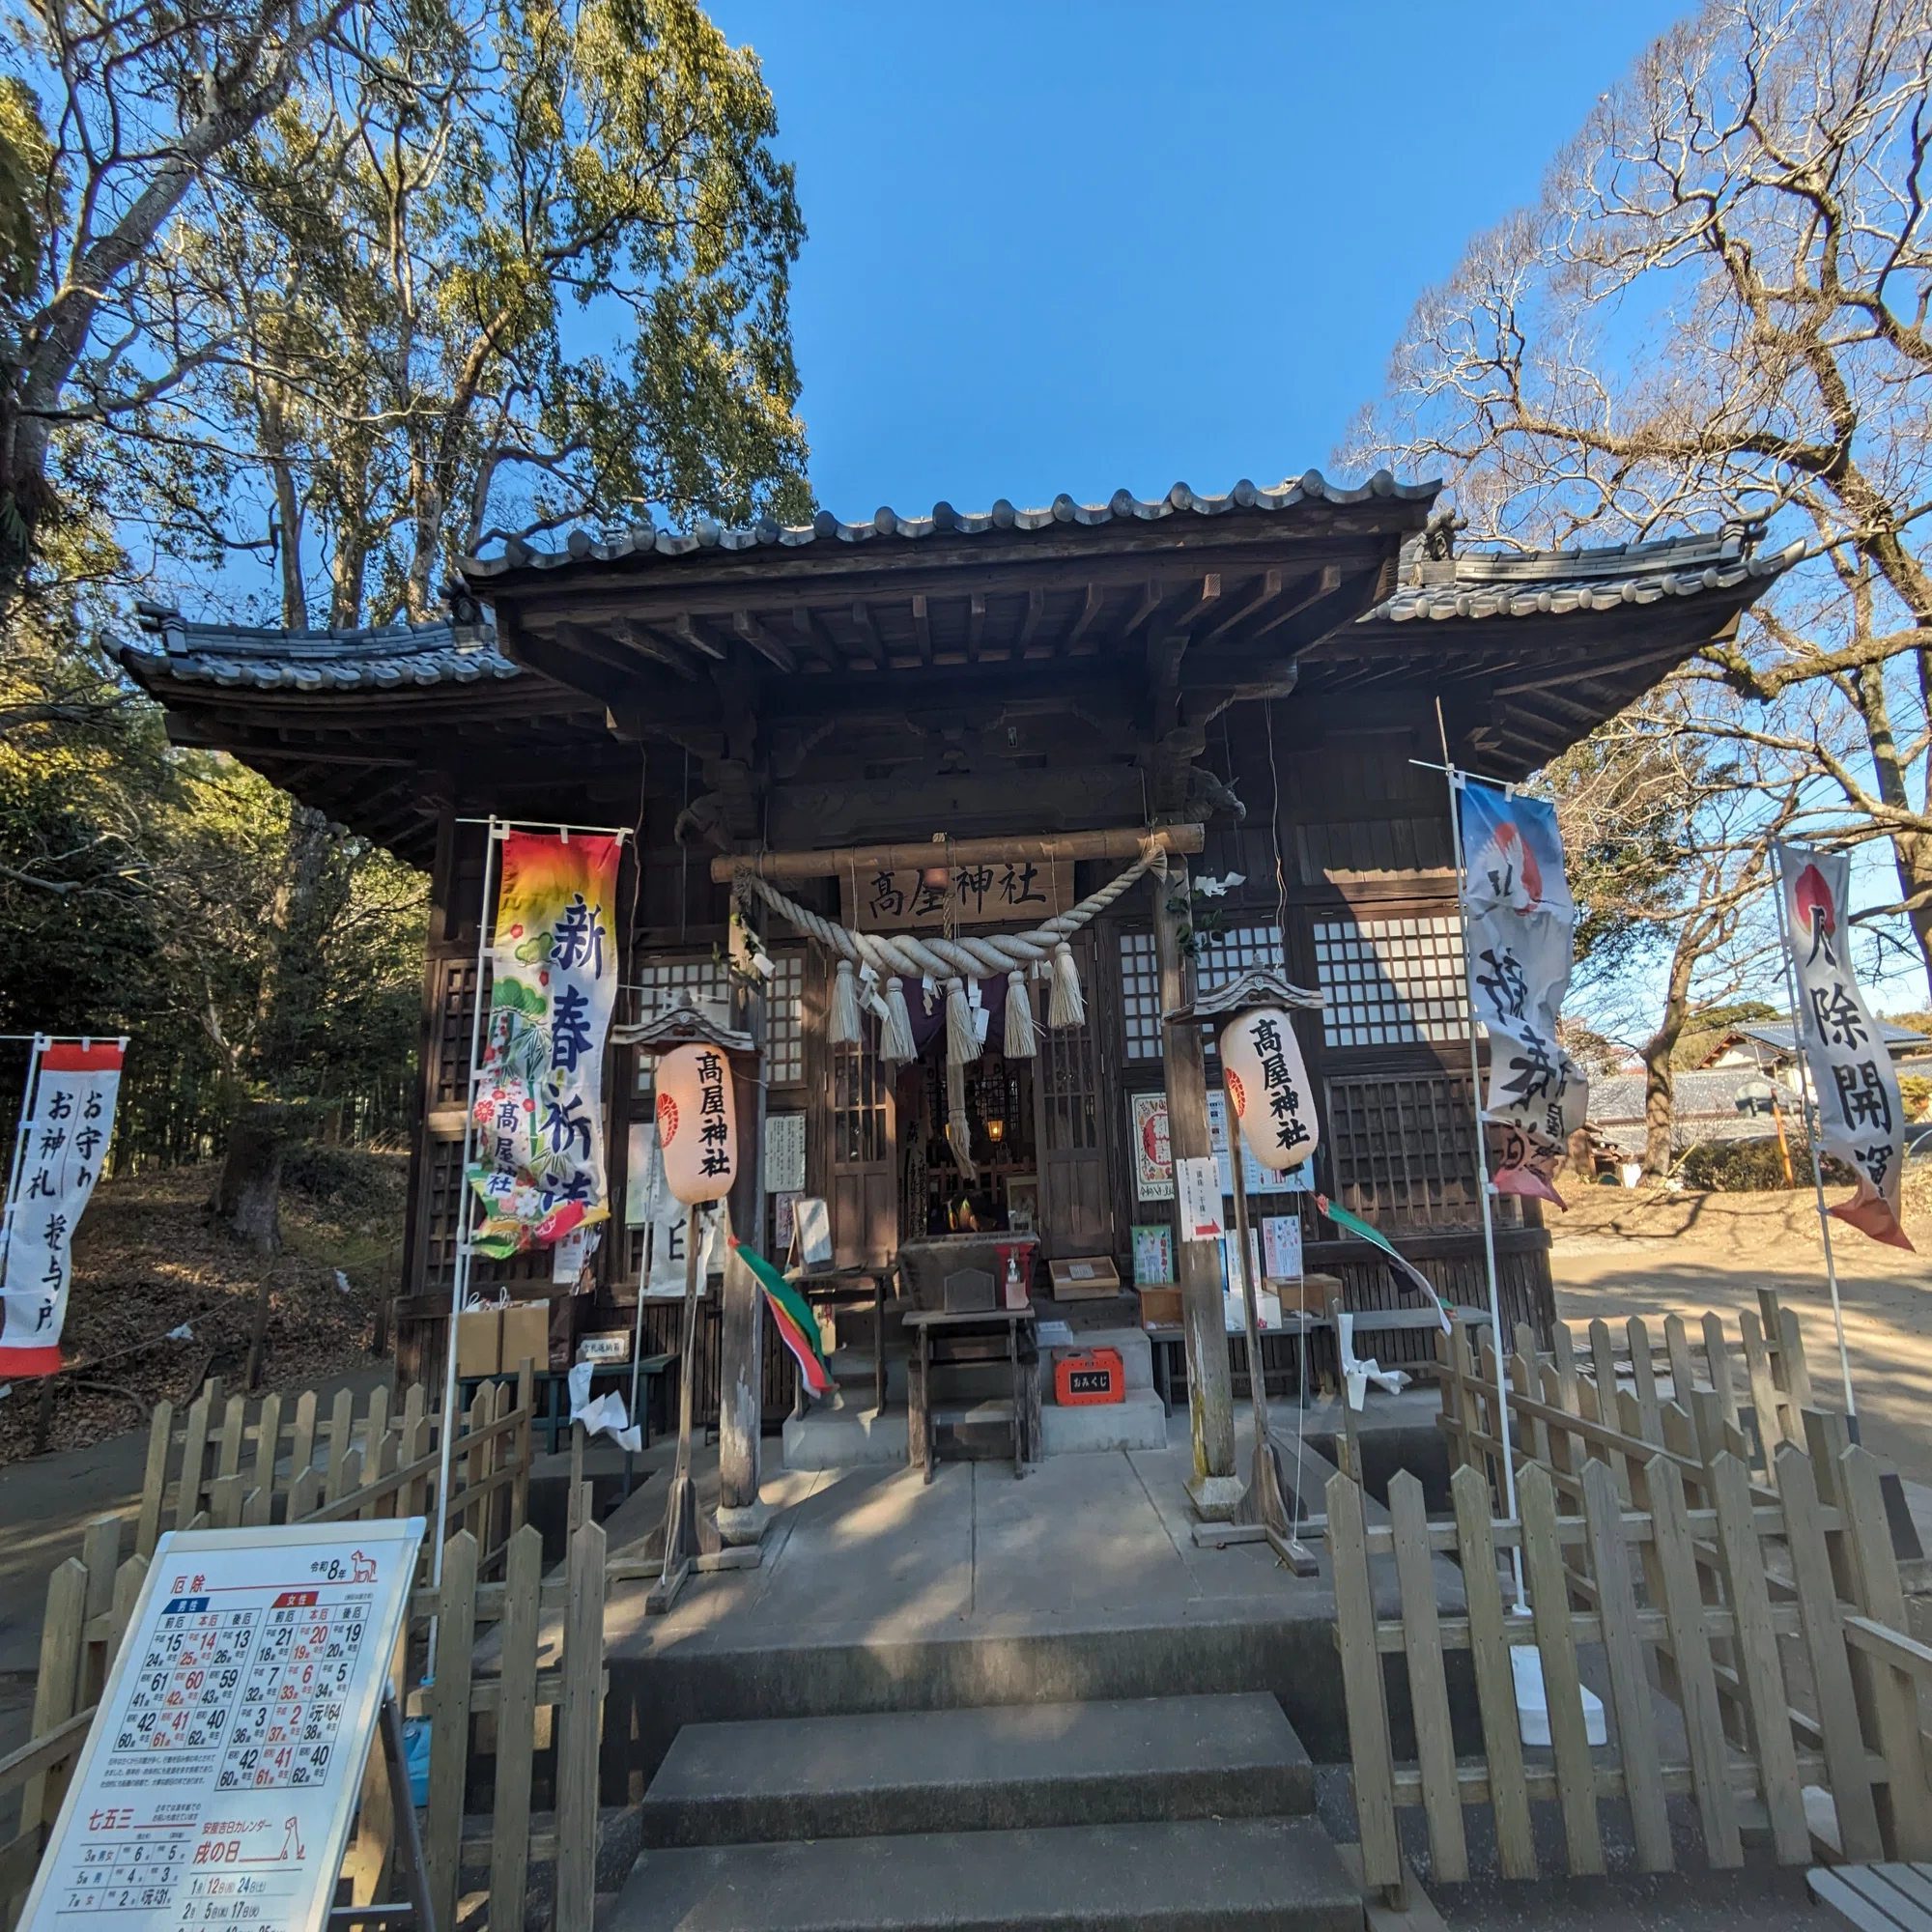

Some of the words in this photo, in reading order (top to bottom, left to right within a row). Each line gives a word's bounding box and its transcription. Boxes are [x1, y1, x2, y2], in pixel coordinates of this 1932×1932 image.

[27, 1092, 73, 1199] お神札
[75, 1091, 103, 1188] お守り
[1074, 1377, 1107, 1387] おみくじ
[171, 1575, 206, 1594] 厄除
[288, 1595, 306, 1605] 女性
[198, 1615, 219, 1627] 本厄
[309, 1609, 328, 1620] 本厄
[166, 1634, 184, 1652] 15
[200, 1632, 217, 1650] 14
[234, 1630, 250, 1649] 13
[275, 1628, 293, 1646] 21
[309, 1626, 328, 1644] 20
[346, 1624, 361, 1642] 19
[152, 1673, 169, 1691] 61
[185, 1671, 204, 1690] 60
[219, 1669, 238, 1688] 59
[268, 1667, 279, 1686] 7
[301, 1664, 313, 1683] 6
[337, 1663, 347, 1681] 5
[137, 1713, 156, 1732] 42
[172, 1712, 190, 1730] 41
[207, 1710, 225, 1729] 40
[255, 1707, 267, 1727] 3
[290, 1705, 301, 1724] 2
[240, 1748, 258, 1770] 42
[274, 1747, 292, 1768] 41
[310, 1746, 329, 1766] 40
[89, 1808, 134, 1831] 七五三
[202, 1822, 272, 1834] 安産吉日カレンダー
[134, 1847, 143, 1861] 6
[168, 1845, 177, 1860] 5
[193, 1841, 241, 1863] 戌の日
[127, 1868, 136, 1884] 4
[161, 1867, 170, 1882] 3
[119, 1891, 128, 1906] 2
